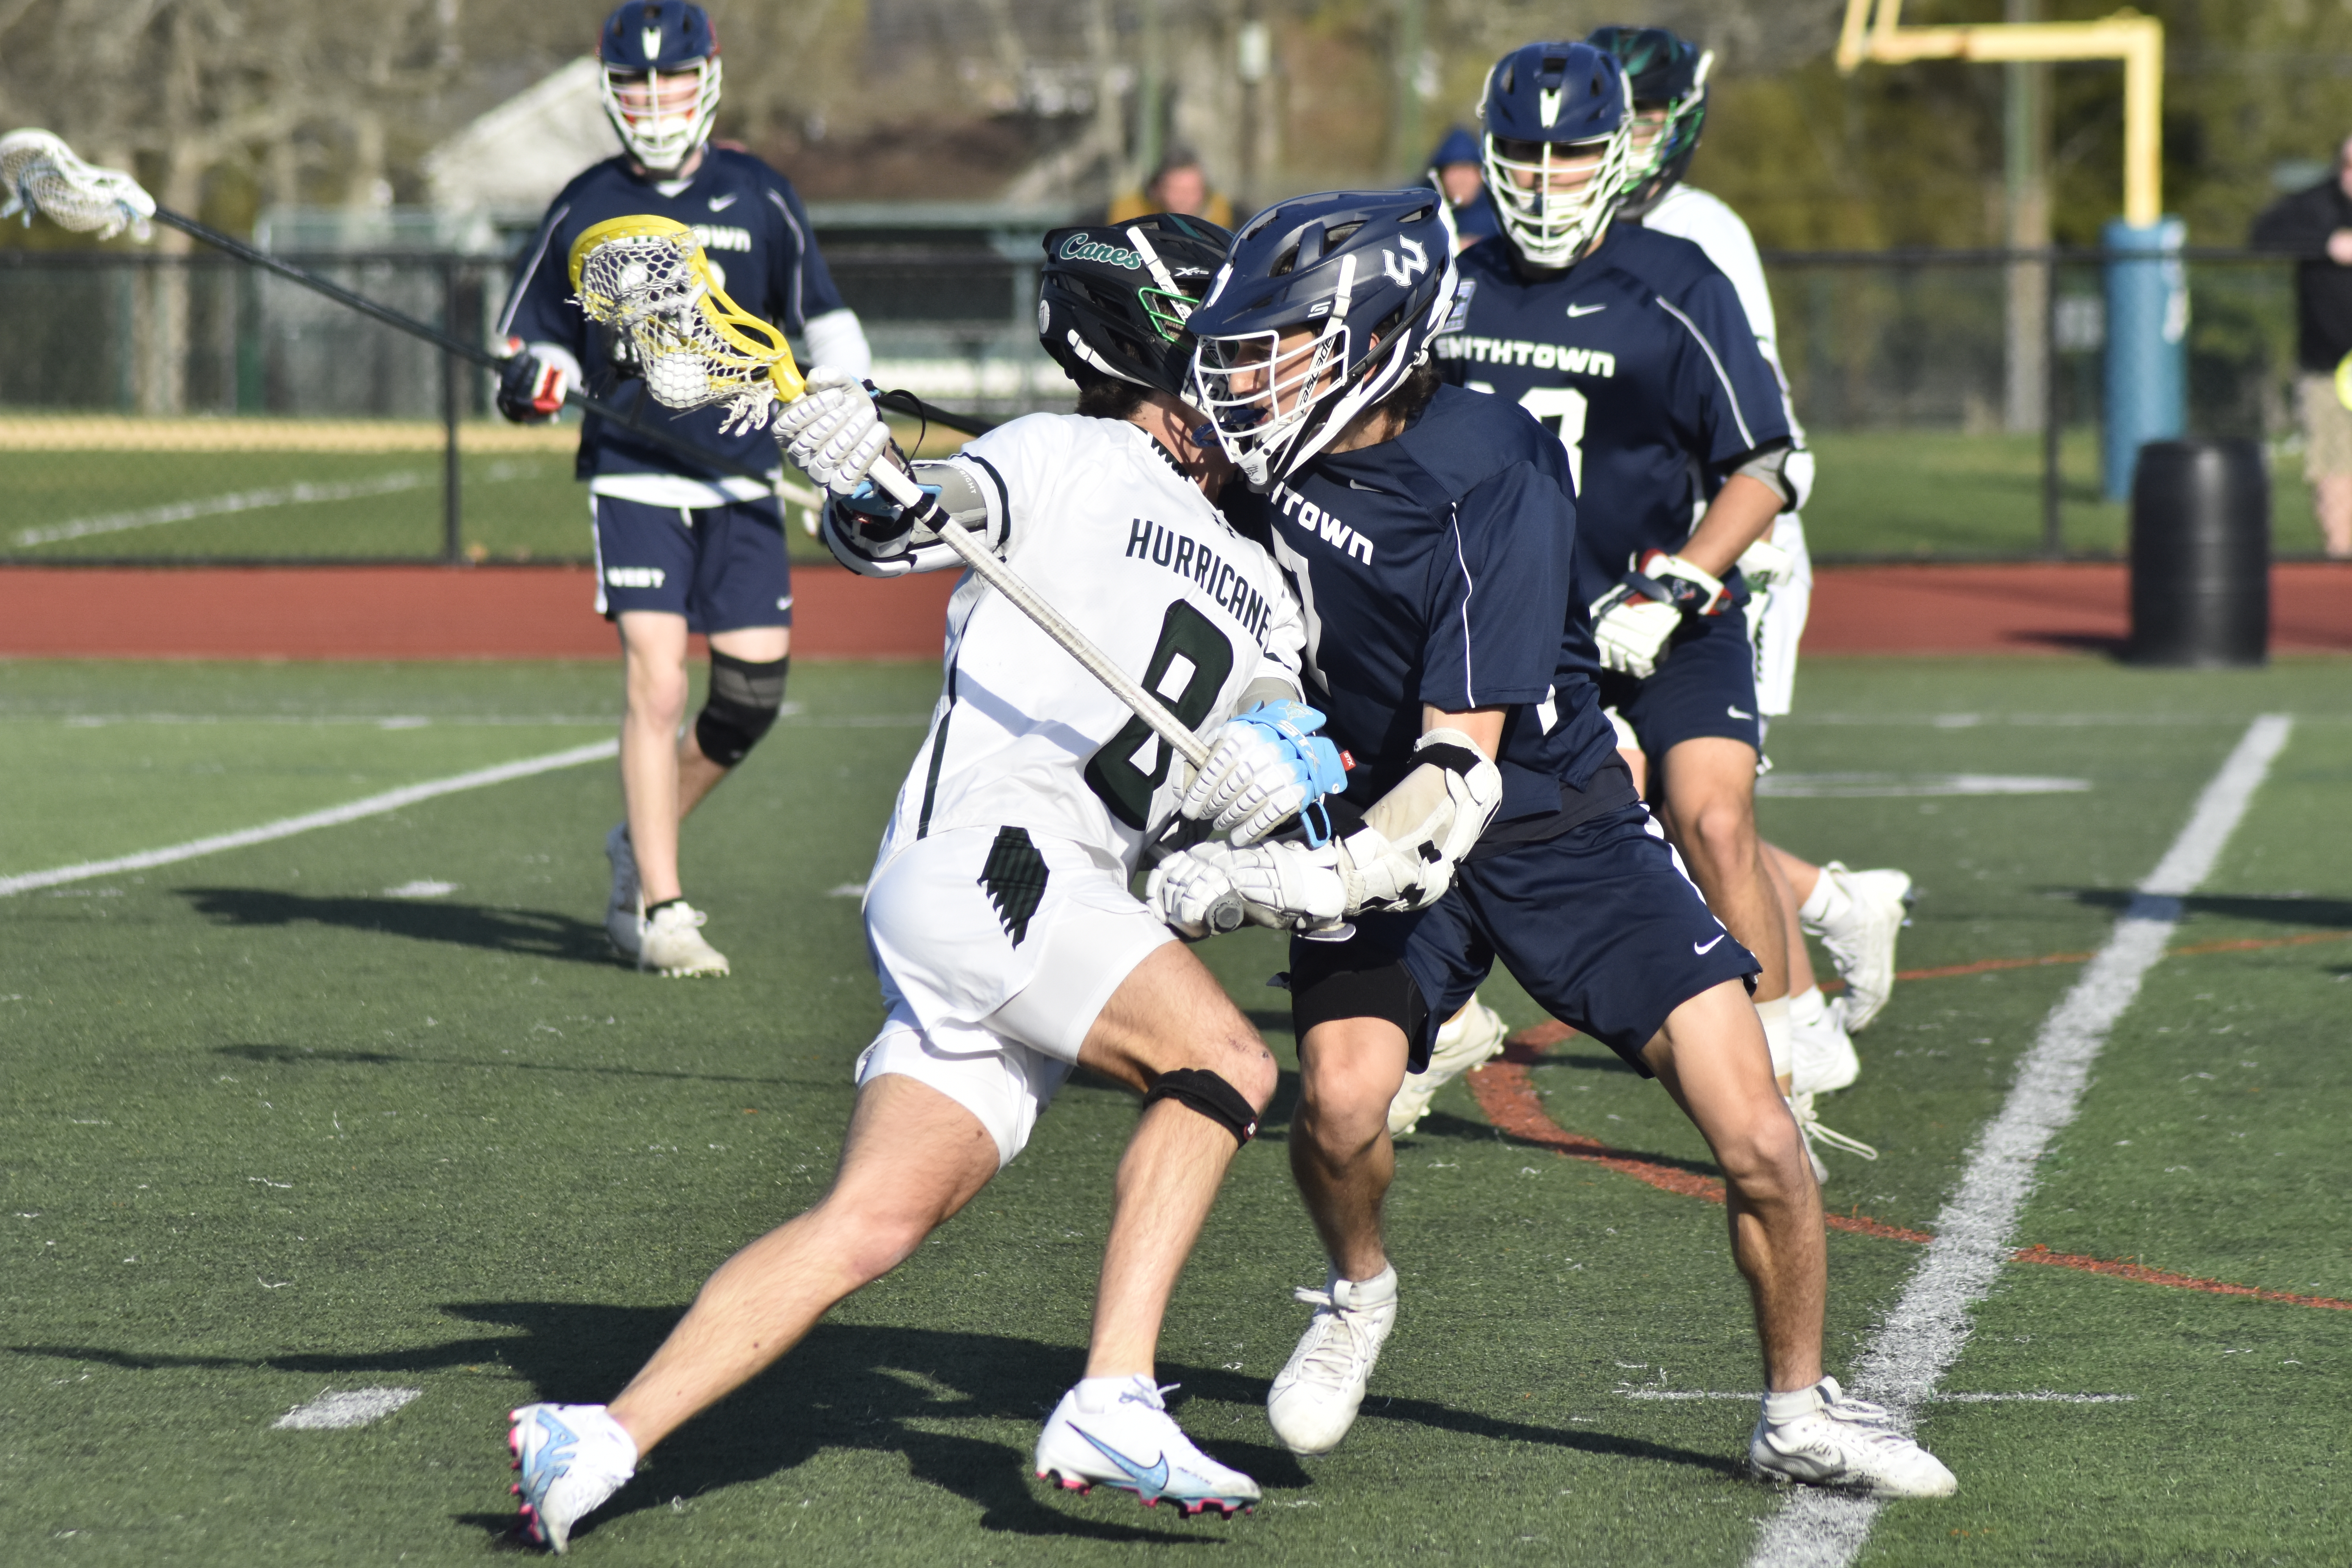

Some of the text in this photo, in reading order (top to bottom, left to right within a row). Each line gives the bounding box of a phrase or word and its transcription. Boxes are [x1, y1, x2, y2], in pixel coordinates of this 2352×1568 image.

[1060, 233, 1143, 270] Canes
[1382, 234, 1428, 287] W
[1174, 267, 1210, 277] XRS
[1434, 336, 1615, 378] SMITHTOWN
[959, 470, 976, 494] RIGHT
[1125, 518, 1272, 649] HURRICANE
[1084, 598, 1233, 831] 8
[1343, 752, 1355, 767] STX
